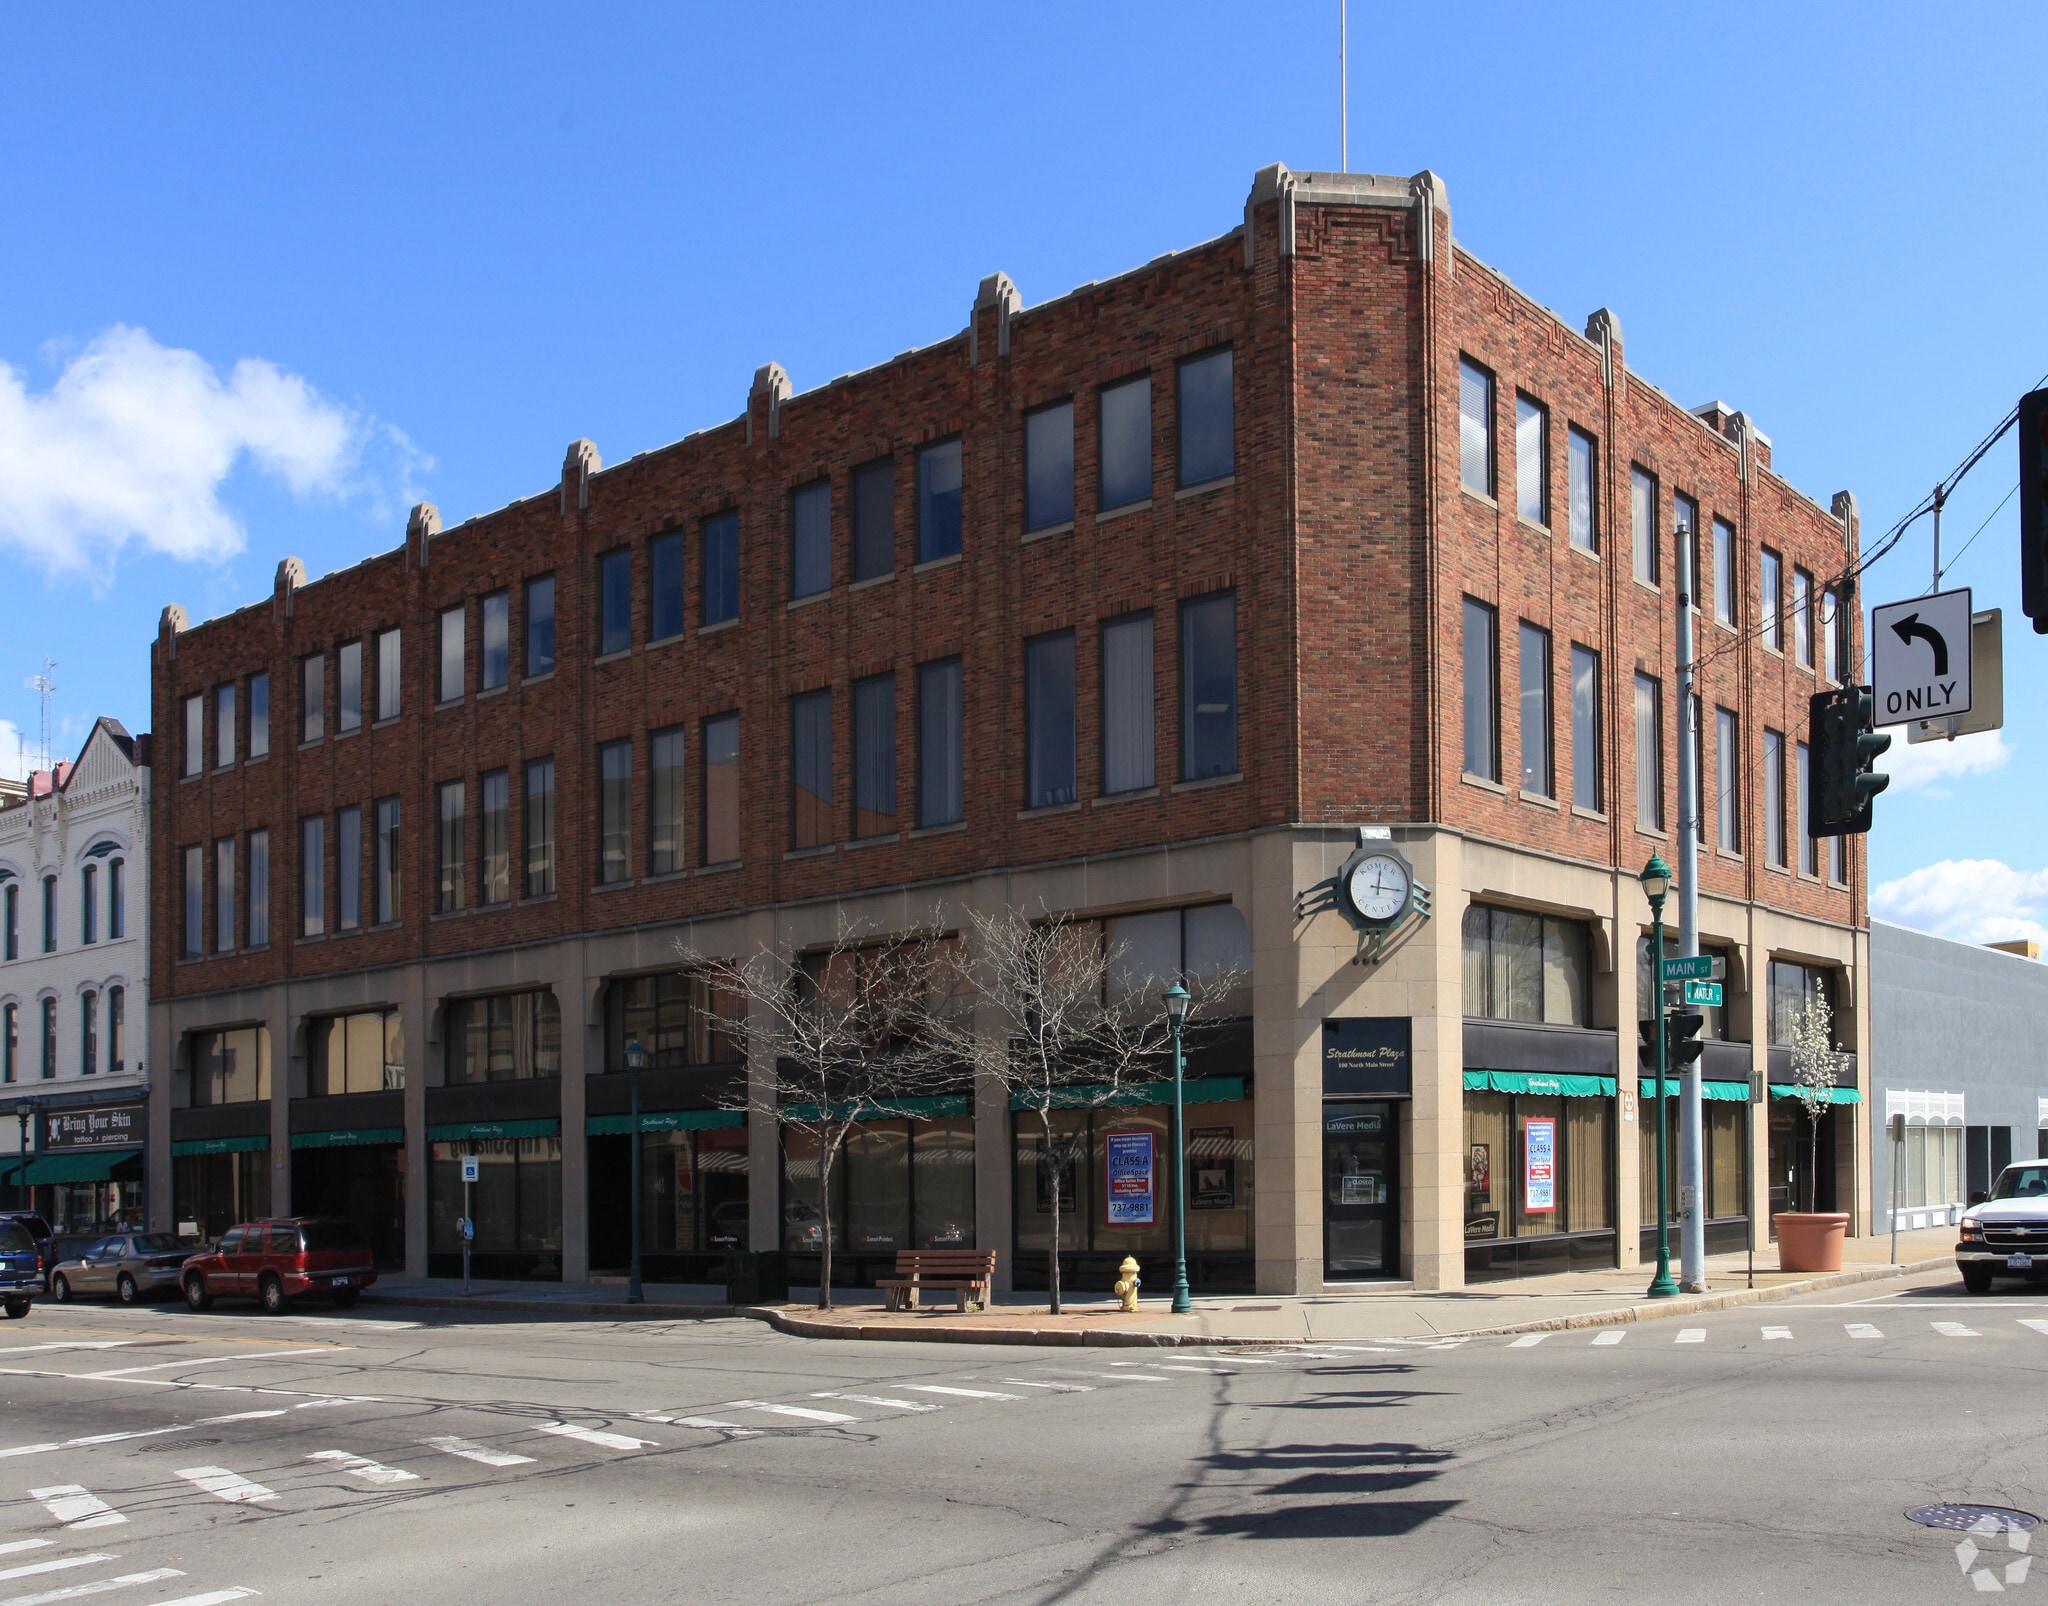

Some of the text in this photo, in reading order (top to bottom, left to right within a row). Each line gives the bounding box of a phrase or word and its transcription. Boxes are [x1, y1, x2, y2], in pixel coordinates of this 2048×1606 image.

[1886, 681, 1957, 714] ONLY
[1360, 862, 1397, 876] KOMER
[1358, 898, 1401, 914] CENTER
[1666, 962, 1708, 977] MAIN ST
[1693, 987, 1714, 1001] WATER
[1326, 1046, 1405, 1061] Strathmont Plaza
[63, 1112, 131, 1133] Bring Your Skin
[1326, 1121, 1381, 1130] LaVere Media
[102, 1133, 129, 1142] piercing
[1530, 1144, 1551, 1153] CLASS A
[1112, 1156, 1148, 1166] CLASS A
[1131, 1169, 1149, 1177] Space
[1112, 1203, 1149, 1212] 737-9881
